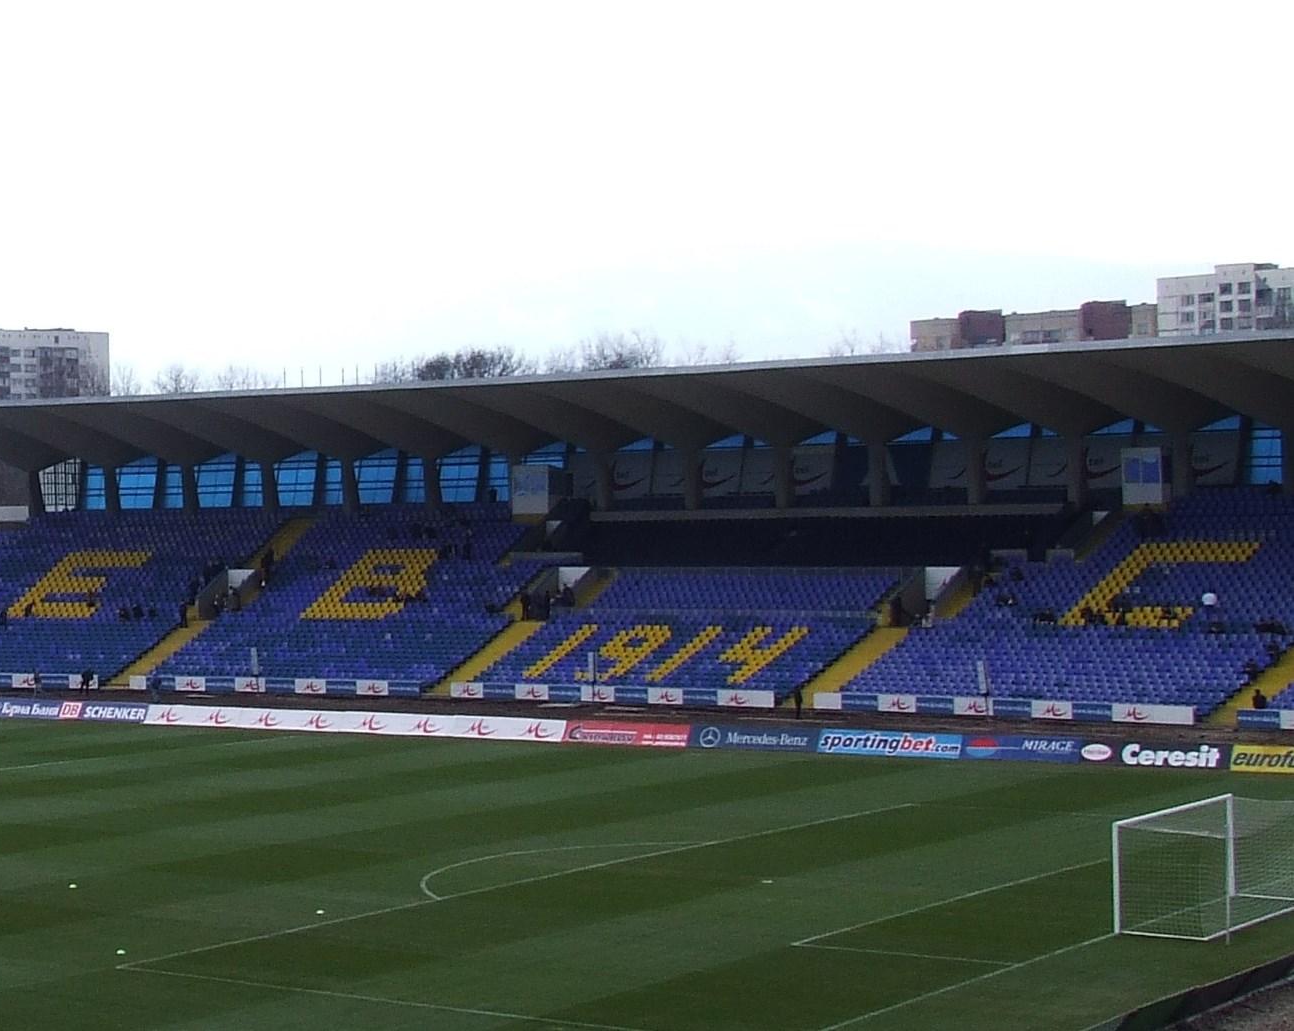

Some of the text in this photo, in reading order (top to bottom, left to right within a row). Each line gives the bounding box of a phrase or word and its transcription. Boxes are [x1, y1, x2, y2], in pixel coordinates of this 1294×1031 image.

[522, 624, 810, 684] 1914
[62, 702, 147, 721] DB SCHENKER
[726, 731, 808, 746] Mercedes-Benz
[820, 731, 960, 756] sportingbet.com
[1022, 739, 1075, 752] MIRAGE
[1121, 743, 1220, 769] Ceresit
